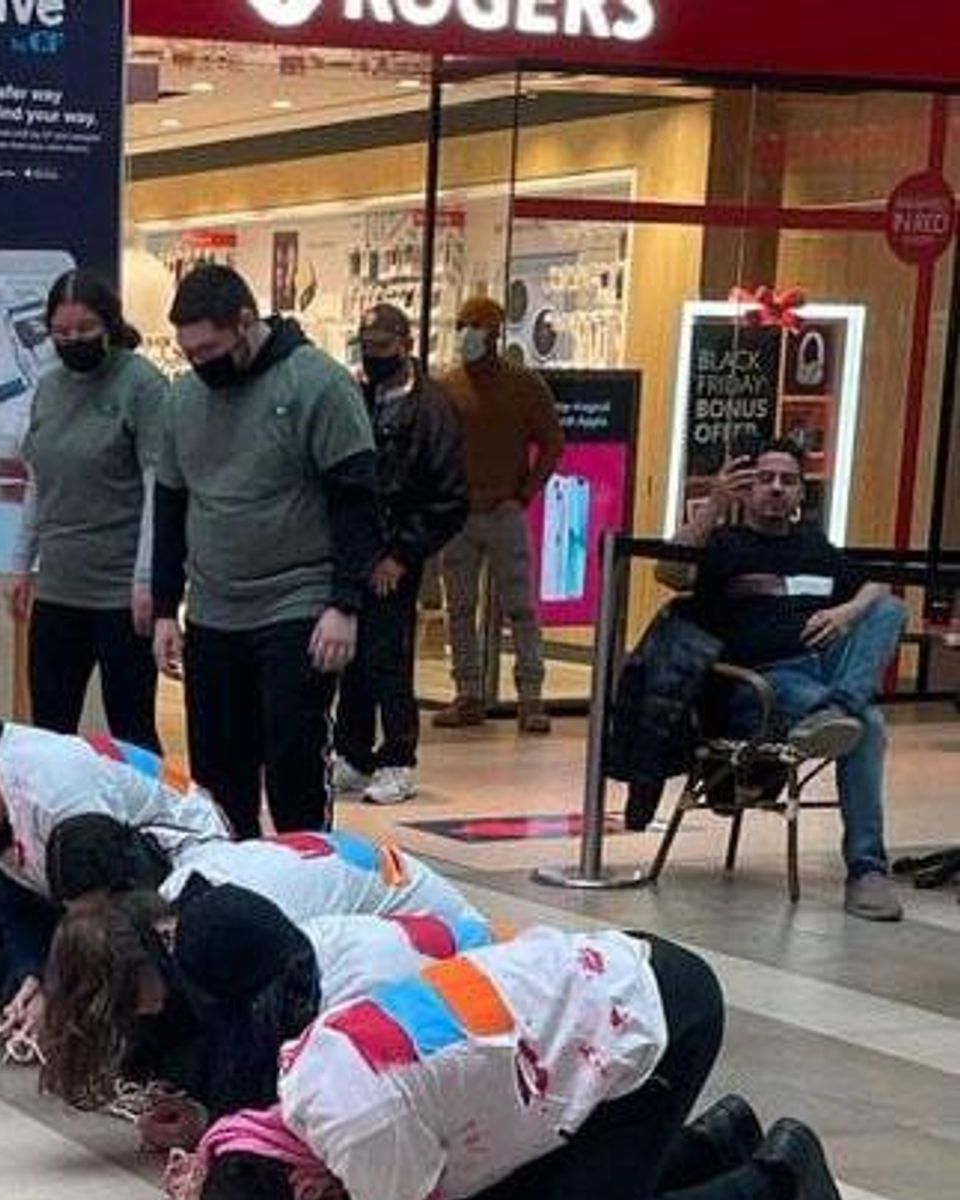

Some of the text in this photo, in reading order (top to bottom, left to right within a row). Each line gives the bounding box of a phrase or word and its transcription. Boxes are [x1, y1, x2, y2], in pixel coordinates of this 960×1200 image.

[344, 0, 654, 40] OGERS
[30, 89, 64, 105] way
[25, 109, 61, 126] your
[698, 350, 761, 371] BLACK
[697, 374, 767, 396] FRIDAY
[695, 398, 769, 418] BONUS
